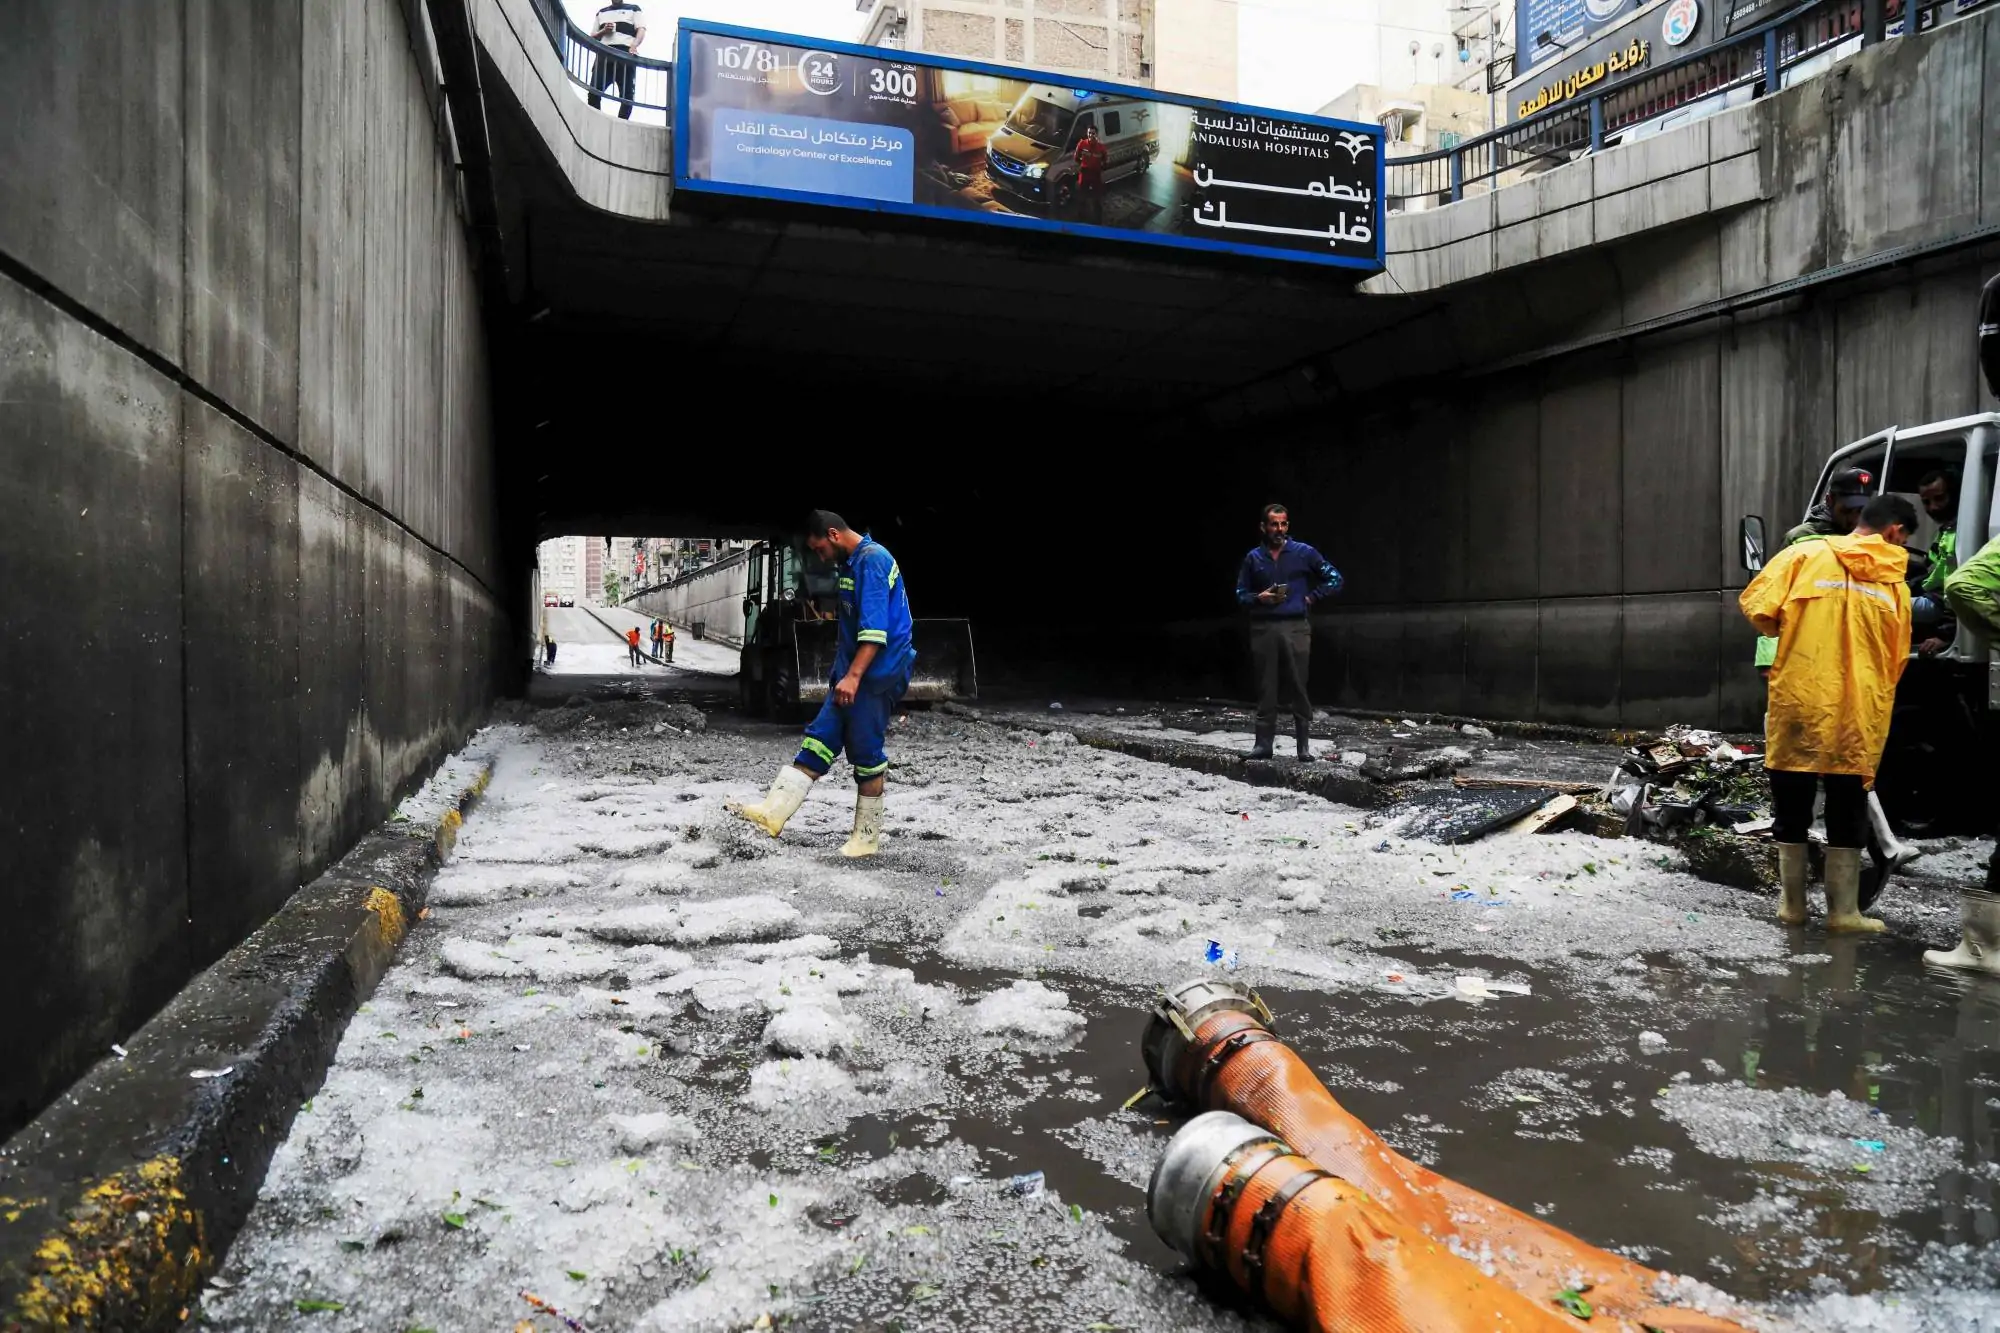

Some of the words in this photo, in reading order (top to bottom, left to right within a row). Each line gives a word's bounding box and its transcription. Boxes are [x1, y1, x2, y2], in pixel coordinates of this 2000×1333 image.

[715, 43, 780, 73] 16781
[810, 61, 834, 77] 24
[810, 78, 834, 86] HOURS
[870, 68, 917, 97] 300
[1566, 61, 1605, 99] سكان
[725, 120, 765, 136] القلب
[769, 123, 808, 139] لصحة
[811, 128, 868, 146] متكامل
[1257, 121, 1330, 143] مستشفيات
[870, 135, 903, 152] مركز
[1190, 131, 1260, 150] ANDALUSIA
[1265, 142, 1330, 159] HOSPITALS
[736, 143, 792, 158] Cardiology
[793, 148, 828, 160] Center
[829, 153, 841, 162] of
[841, 154, 893, 167] Excellence
